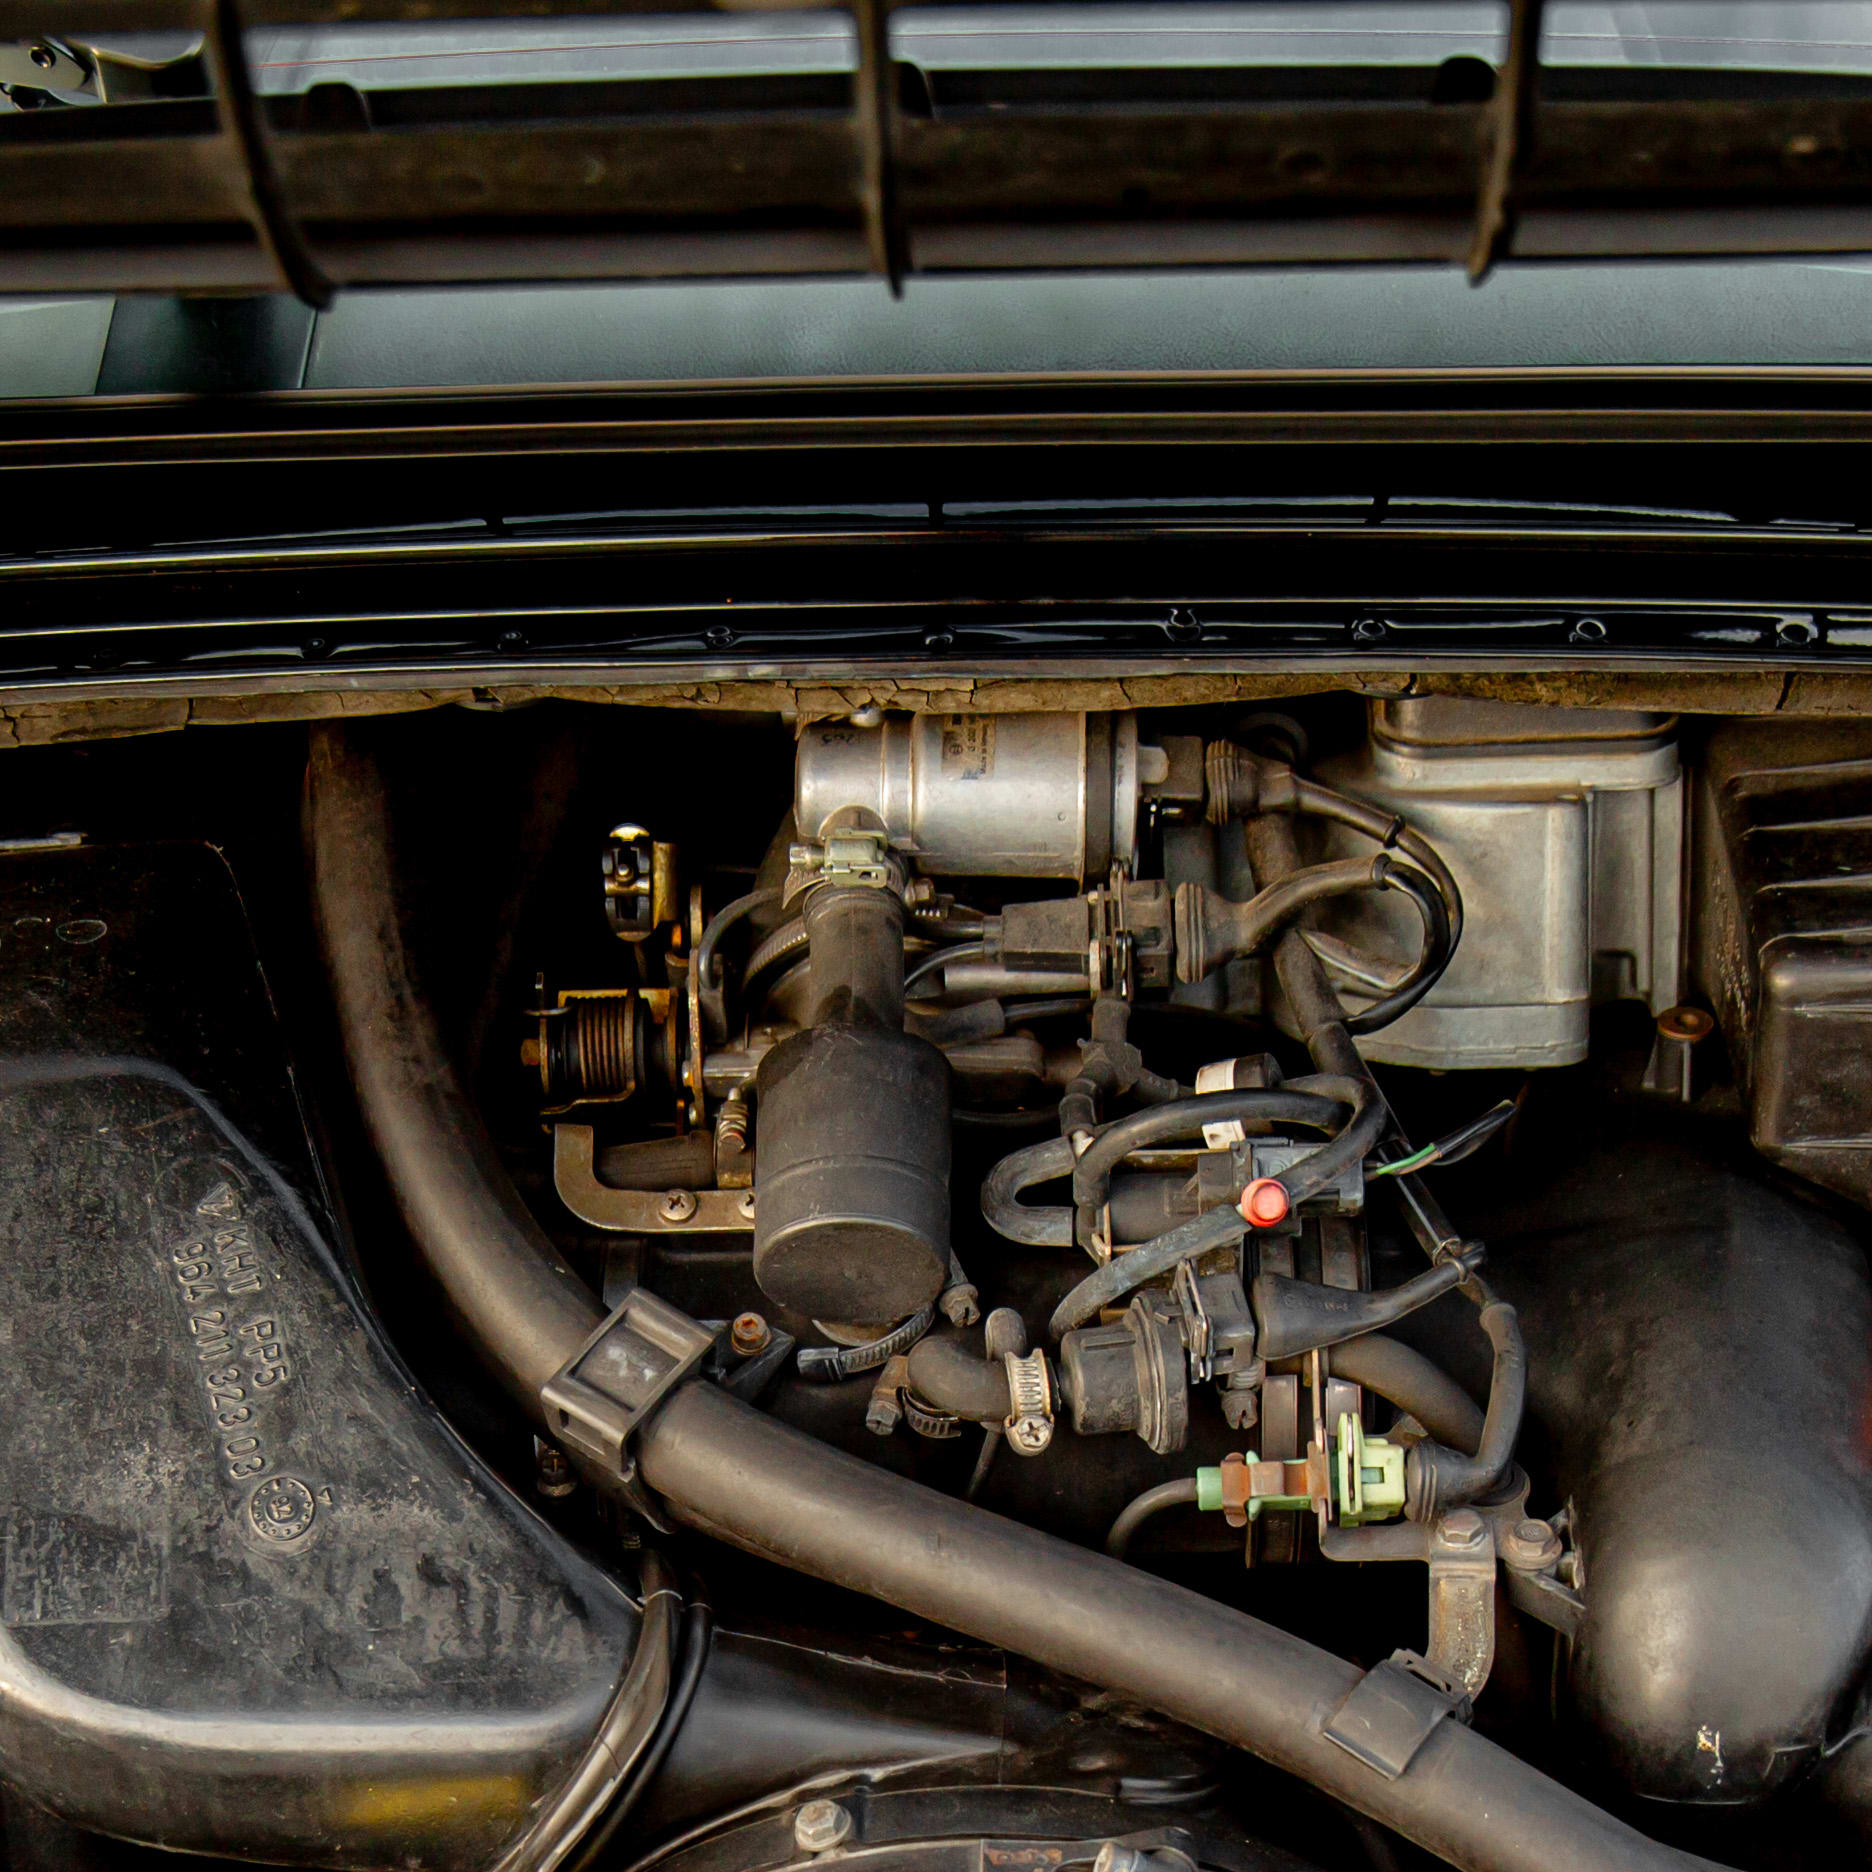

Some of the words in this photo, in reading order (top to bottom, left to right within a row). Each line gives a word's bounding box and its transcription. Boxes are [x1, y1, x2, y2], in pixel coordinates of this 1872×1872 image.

[173, 1241, 217, 1301] 964
[191, 1311, 233, 1361] 211
[207, 1368, 253, 1428] 323
[226, 1436, 266, 1480] 03
